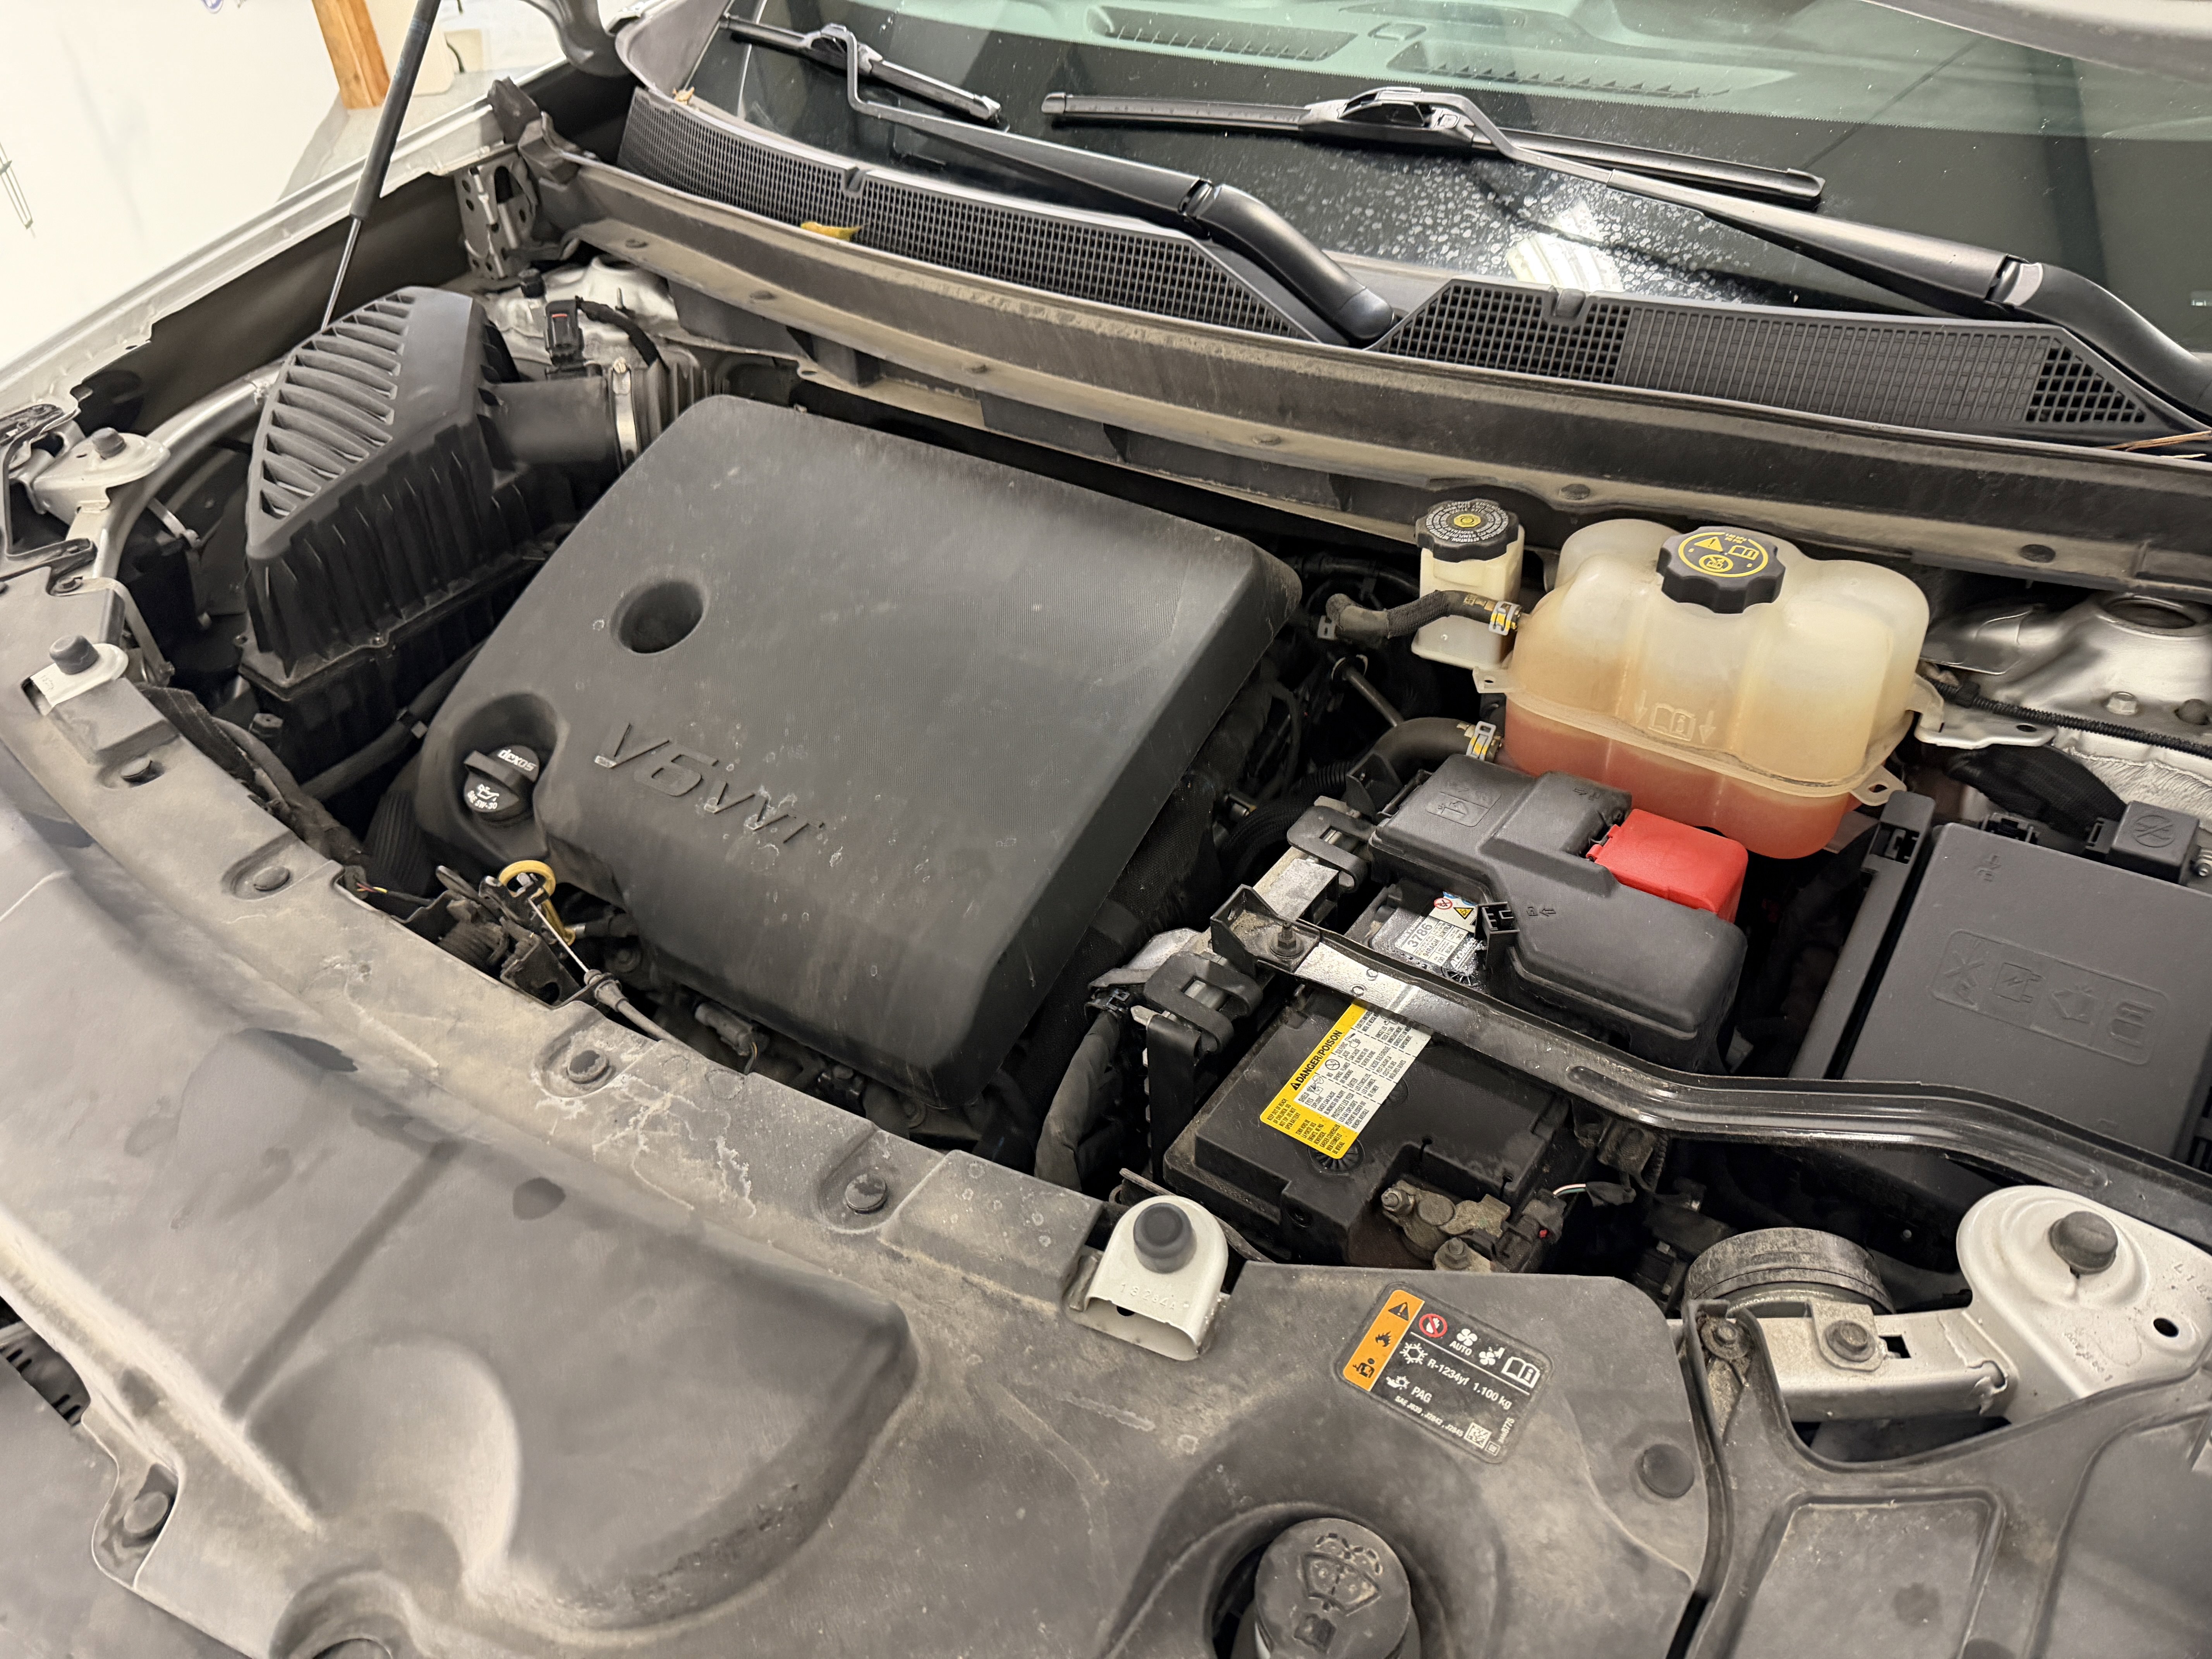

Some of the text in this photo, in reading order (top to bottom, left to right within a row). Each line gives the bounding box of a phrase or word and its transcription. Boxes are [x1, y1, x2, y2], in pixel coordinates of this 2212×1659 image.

[498, 749, 537, 771] dexos
[475, 801, 498, 810] 5W-30
[1295, 1029, 1343, 1084] DANGER/POISON
[1298, 1092, 1309, 1102] SHIELD
[1344, 1092, 1355, 1101] YEUX
[1449, 1340, 1472, 1356] AUTO
[1427, 1358, 1513, 1410] R-1234yf 1.100 kg
[1395, 1396, 1408, 1406] SAE
[1411, 1386, 1432, 1403] PAG
